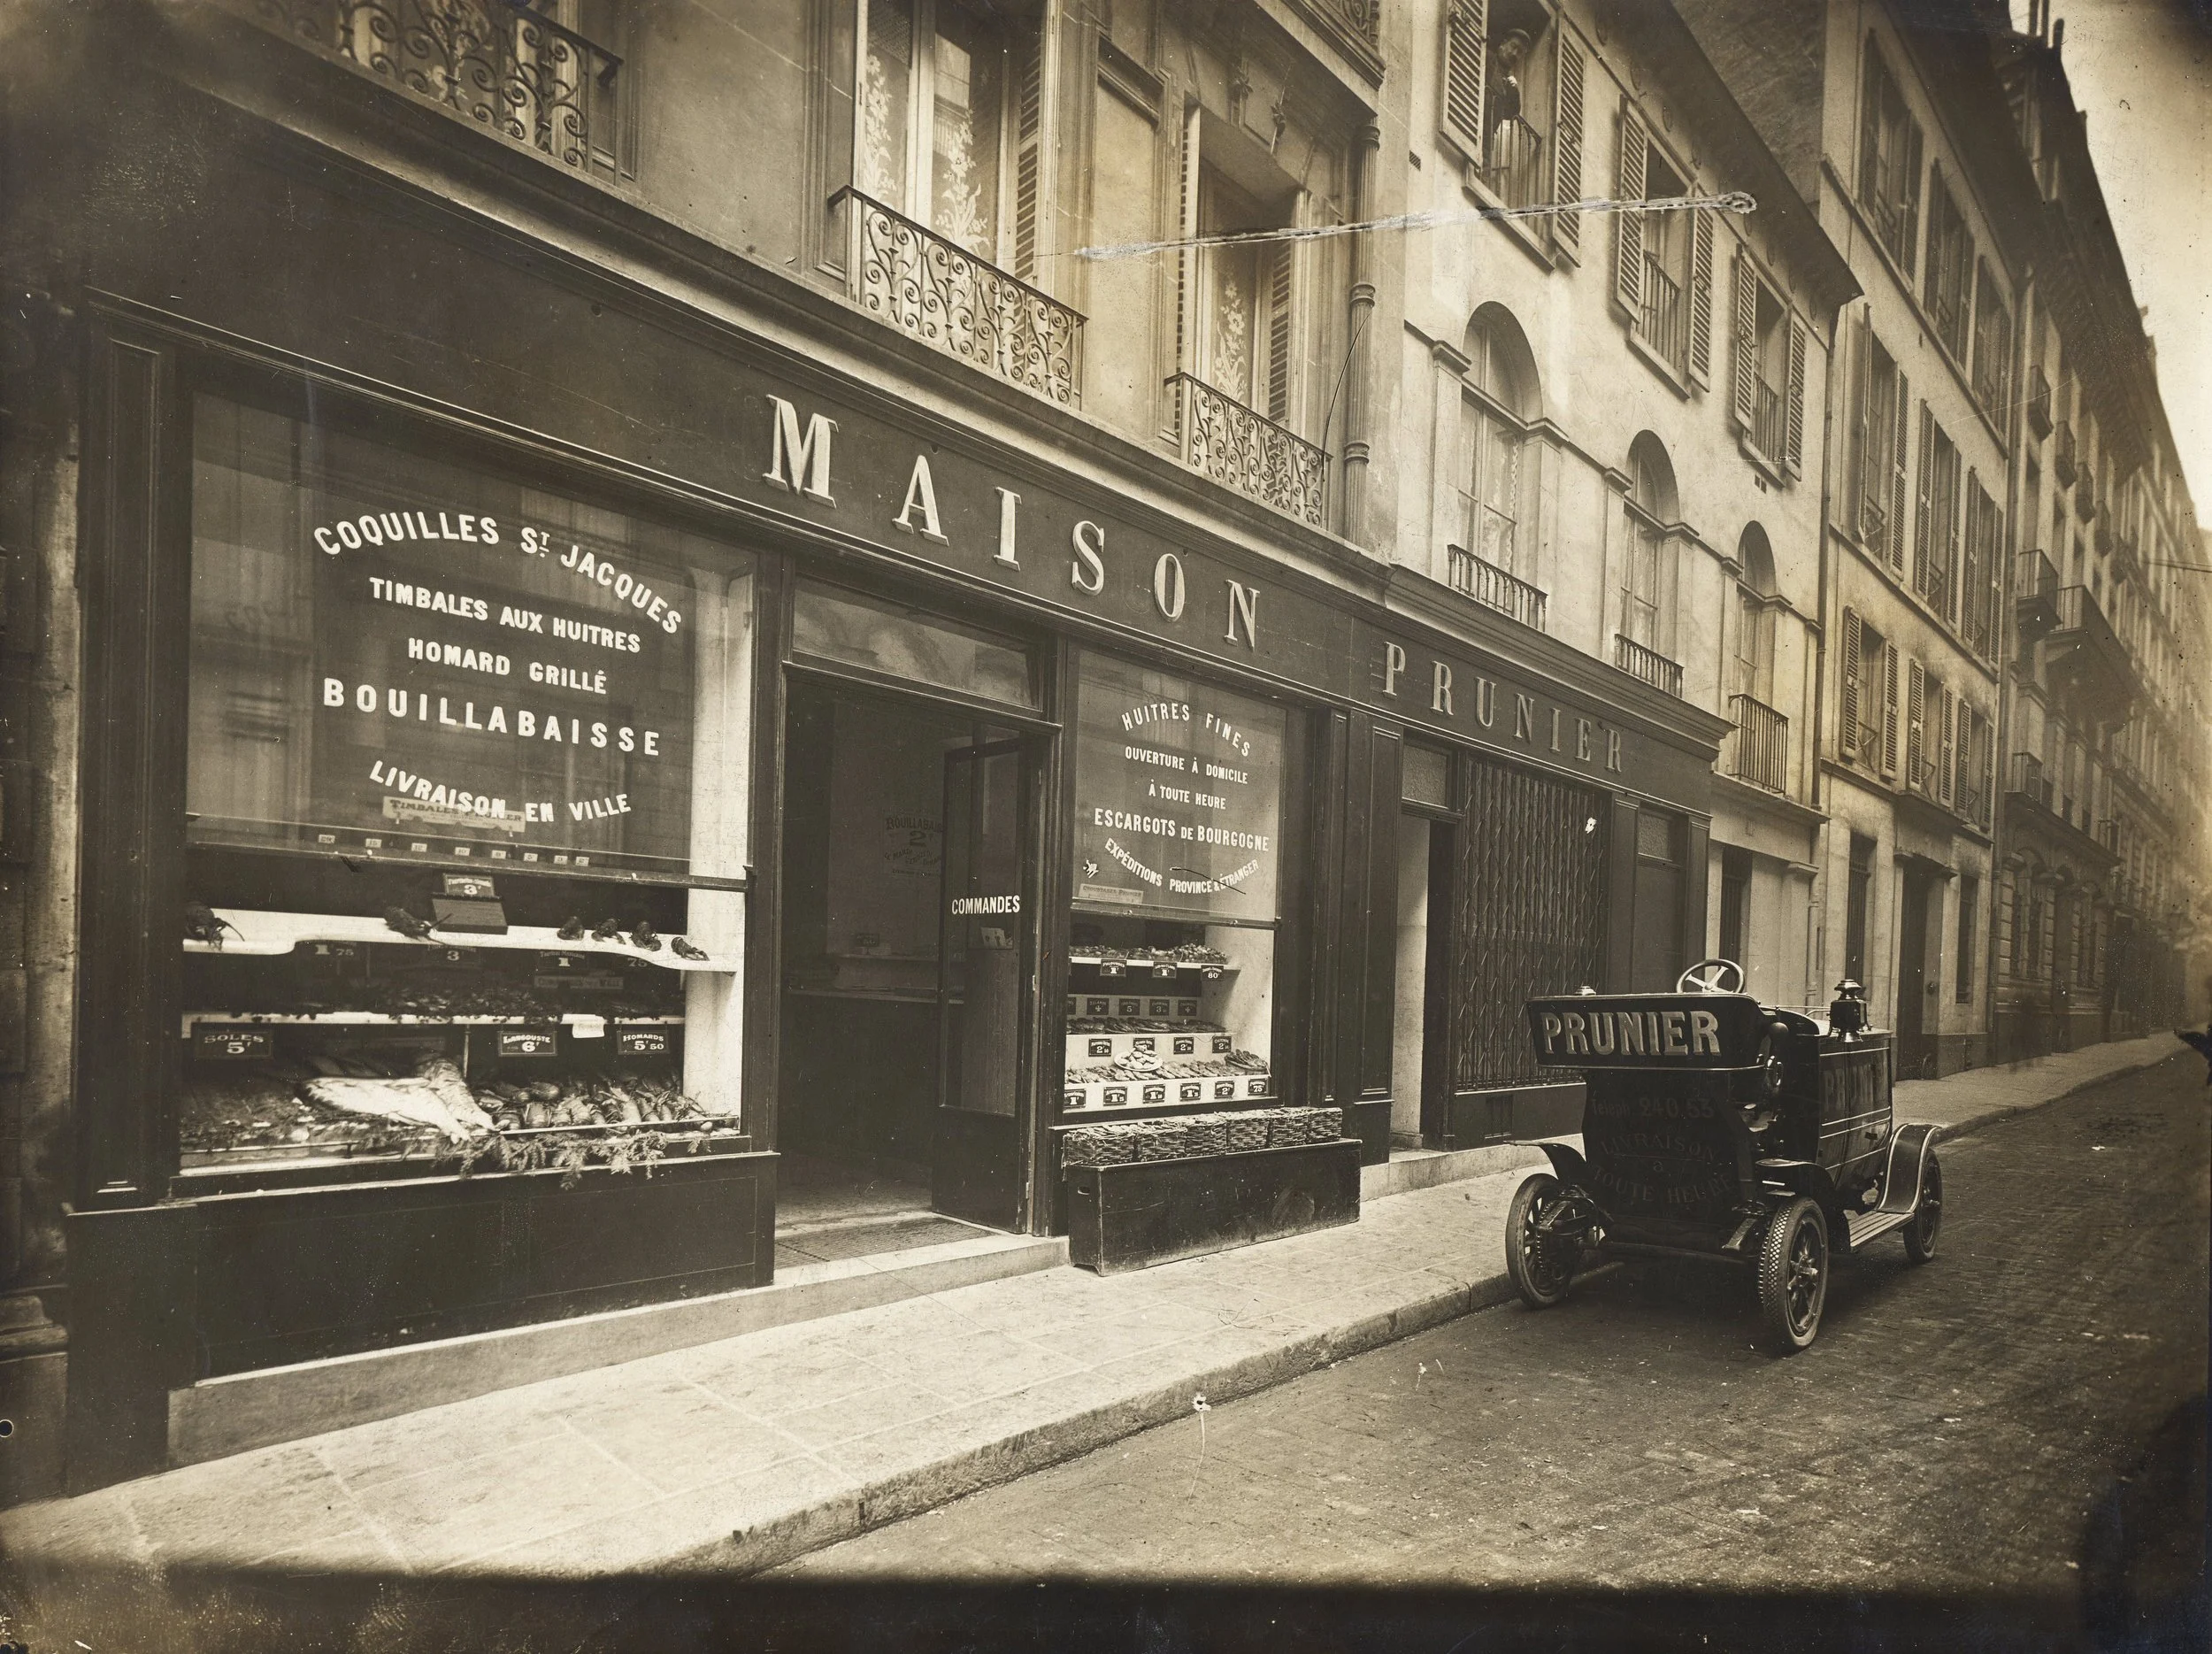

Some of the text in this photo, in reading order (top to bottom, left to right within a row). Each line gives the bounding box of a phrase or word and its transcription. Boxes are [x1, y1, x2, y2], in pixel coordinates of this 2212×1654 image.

[763, 395, 1261, 652] MAISON
[314, 512, 500, 555] COQUILLES
[561, 545, 682, 635] JACQUES
[369, 577, 641, 654] TIMBALES AUX HUITRES
[409, 637, 607, 694] HOMARD GRILLÉ
[324, 677, 659, 757] BOUILLABAISSE
[1121, 703, 1250, 757] HUITRES FINES
[1382, 642, 1622, 773] PRUNIER
[1125, 746, 1186, 771] OUVERTURE
[1205, 764, 1248, 784] DOMICILE
[369, 760, 506, 819] LIVRAISON
[526, 803, 554, 822] EN
[568, 794, 632, 821] VILLE
[1160, 785, 1190, 804] TOUTE
[1194, 792, 1226, 810] HEURE
[1094, 807, 1269, 851] ESCARGOTS DE BOURGOGNE
[1104, 837, 1259, 895] EXPÉDITIONS PROVINCE & ÉTRANGER
[951, 895, 1020, 915] COMMANDES
[204, 1034, 265, 1044] SOLES
[503, 1034, 551, 1044] LANGOUSTE
[623, 1034, 664, 1042] HOMARDS
[1540, 1011, 1722, 1057] PRUNIER
[1600, 1132, 1719, 1162] LIVRAISON
[1592, 1164, 1735, 1204] TOUTE HEURE
